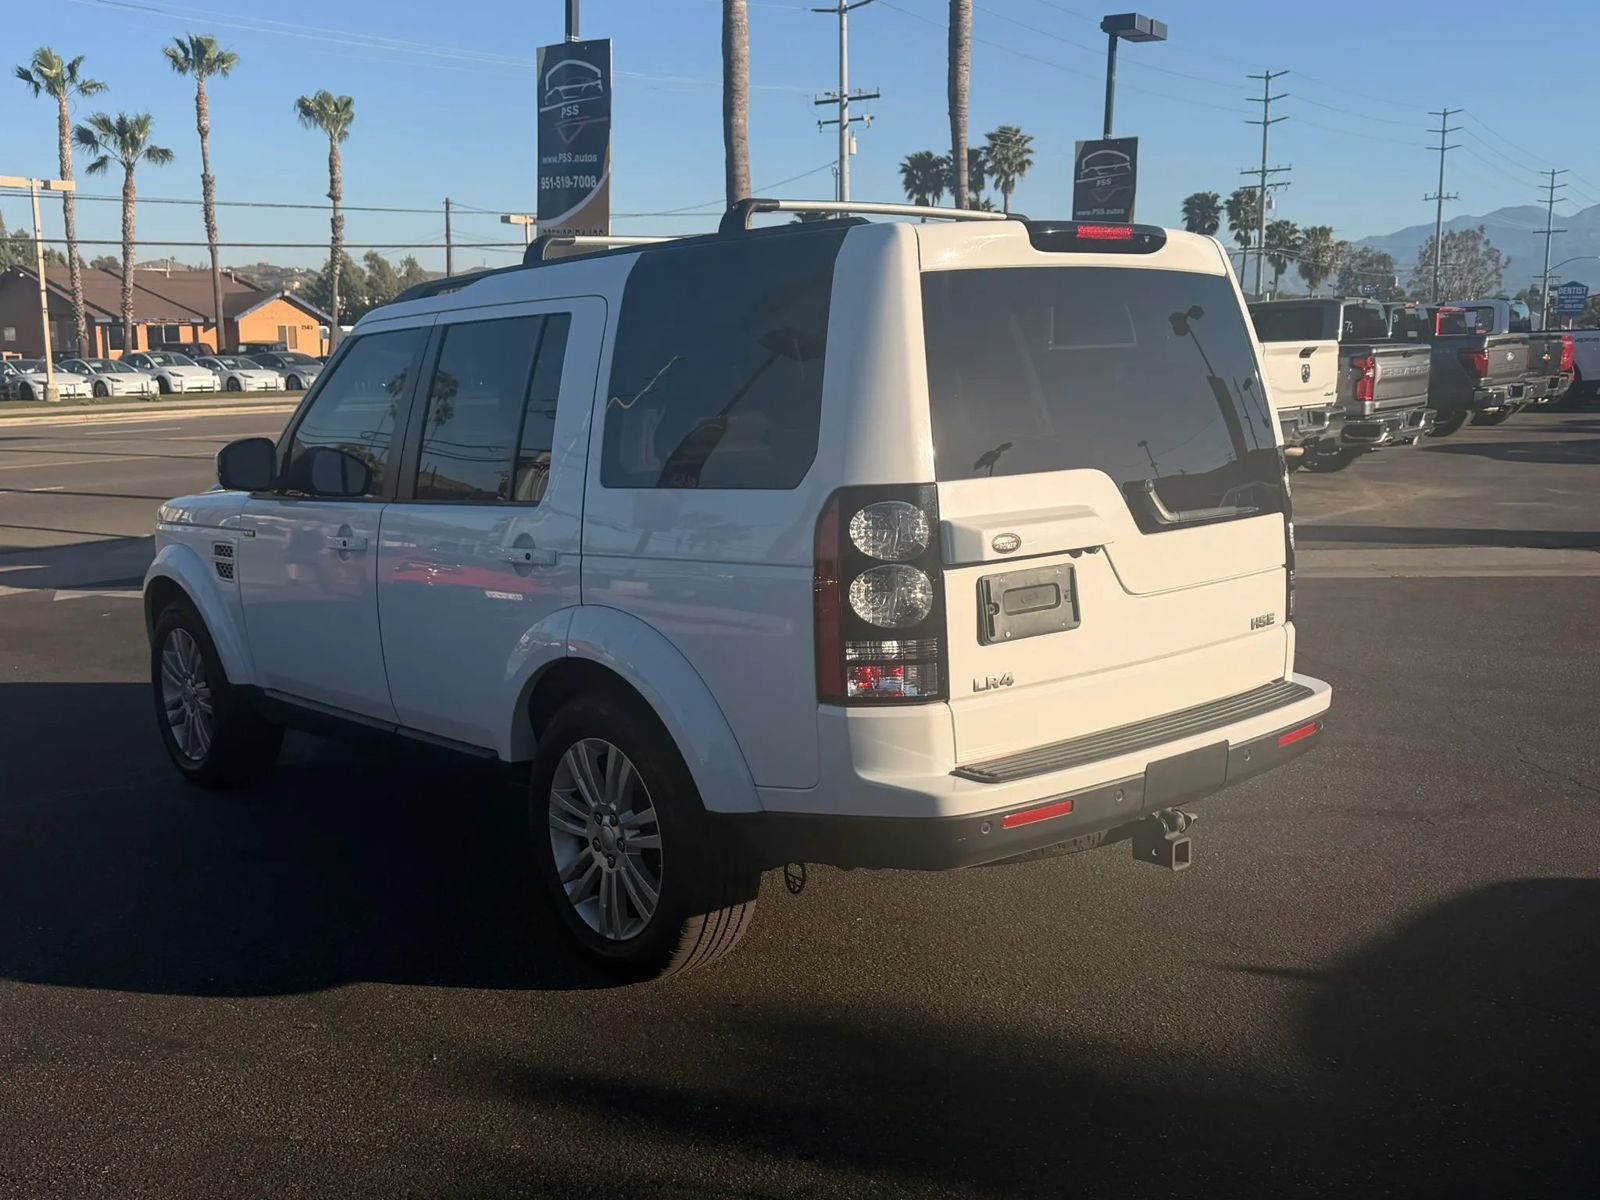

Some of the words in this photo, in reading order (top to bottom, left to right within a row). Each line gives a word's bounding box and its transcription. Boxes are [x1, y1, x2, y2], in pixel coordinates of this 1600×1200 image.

[561, 104, 579, 118] PSS
[543, 152, 598, 163] www.PSS.autos
[541, 175, 597, 190] 951-519-7008
[1558, 286, 1587, 295] DENTIST
[1250, 612, 1275, 631] HSE
[972, 671, 1015, 692] LR4
